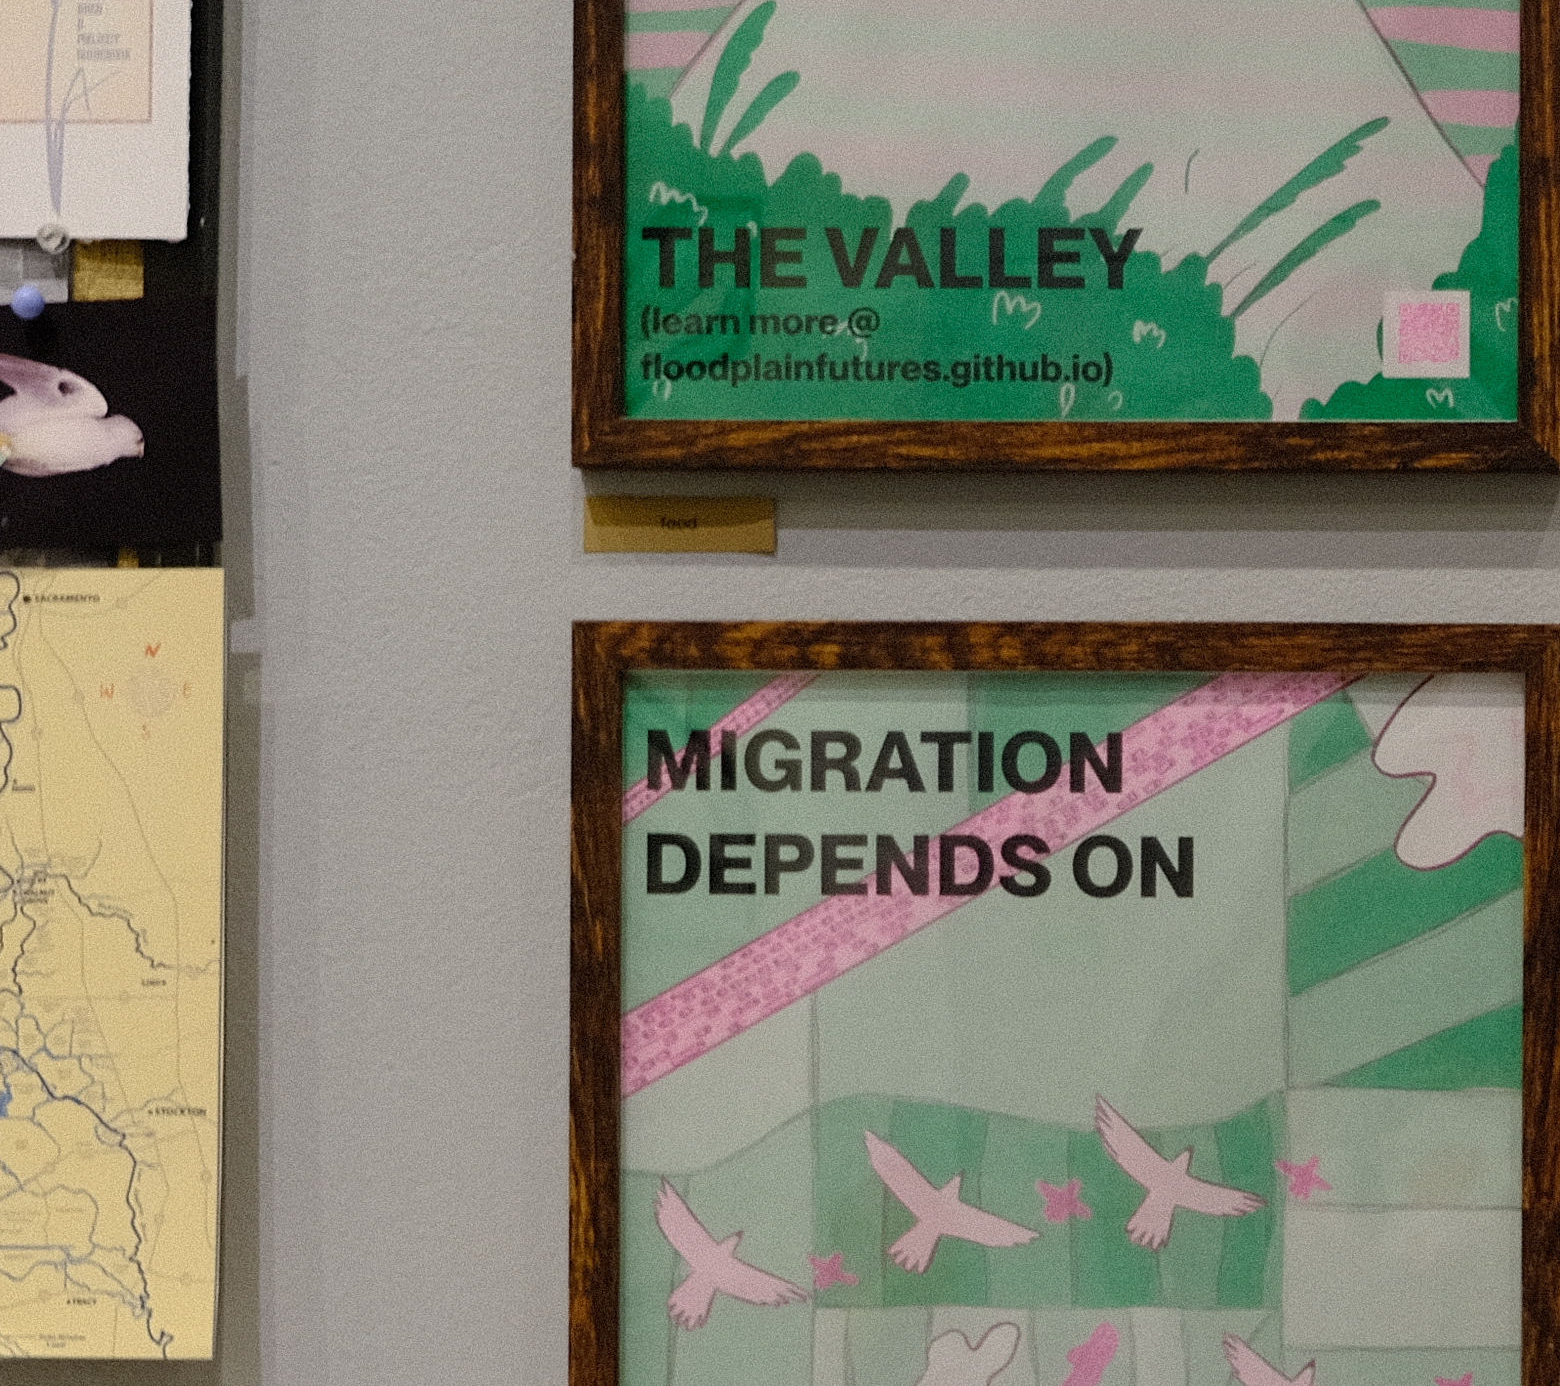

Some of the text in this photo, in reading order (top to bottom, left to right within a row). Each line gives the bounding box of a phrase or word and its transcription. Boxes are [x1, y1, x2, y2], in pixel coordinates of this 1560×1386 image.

[641, 226, 1142, 291] THE VALLEY
[640, 306, 880, 338] (learn more @
[640, 352, 1114, 388] floodplainfutures.github.io)
[660, 515, 697, 531] food
[646, 730, 1123, 794] MIGRATION
[646, 833, 1193, 898] DEPENDS ON
